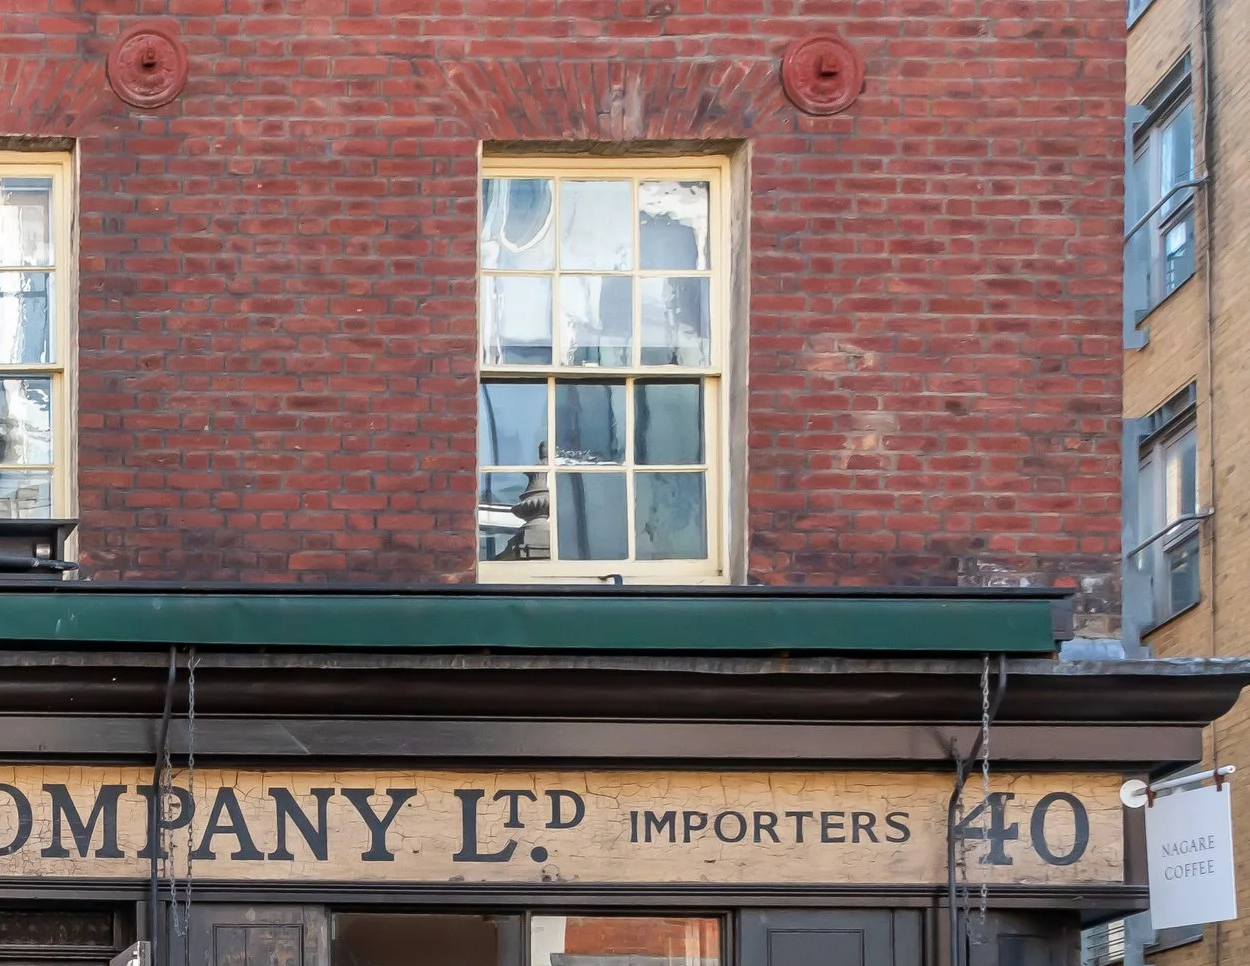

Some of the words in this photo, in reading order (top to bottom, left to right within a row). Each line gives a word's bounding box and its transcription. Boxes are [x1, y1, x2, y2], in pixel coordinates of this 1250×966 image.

[629, 810, 912, 844] IMPORTERS
[952, 790, 1090, 866] 40
[1161, 834, 1215, 858] NAGARE
[1164, 859, 1215, 881] COFFEE
